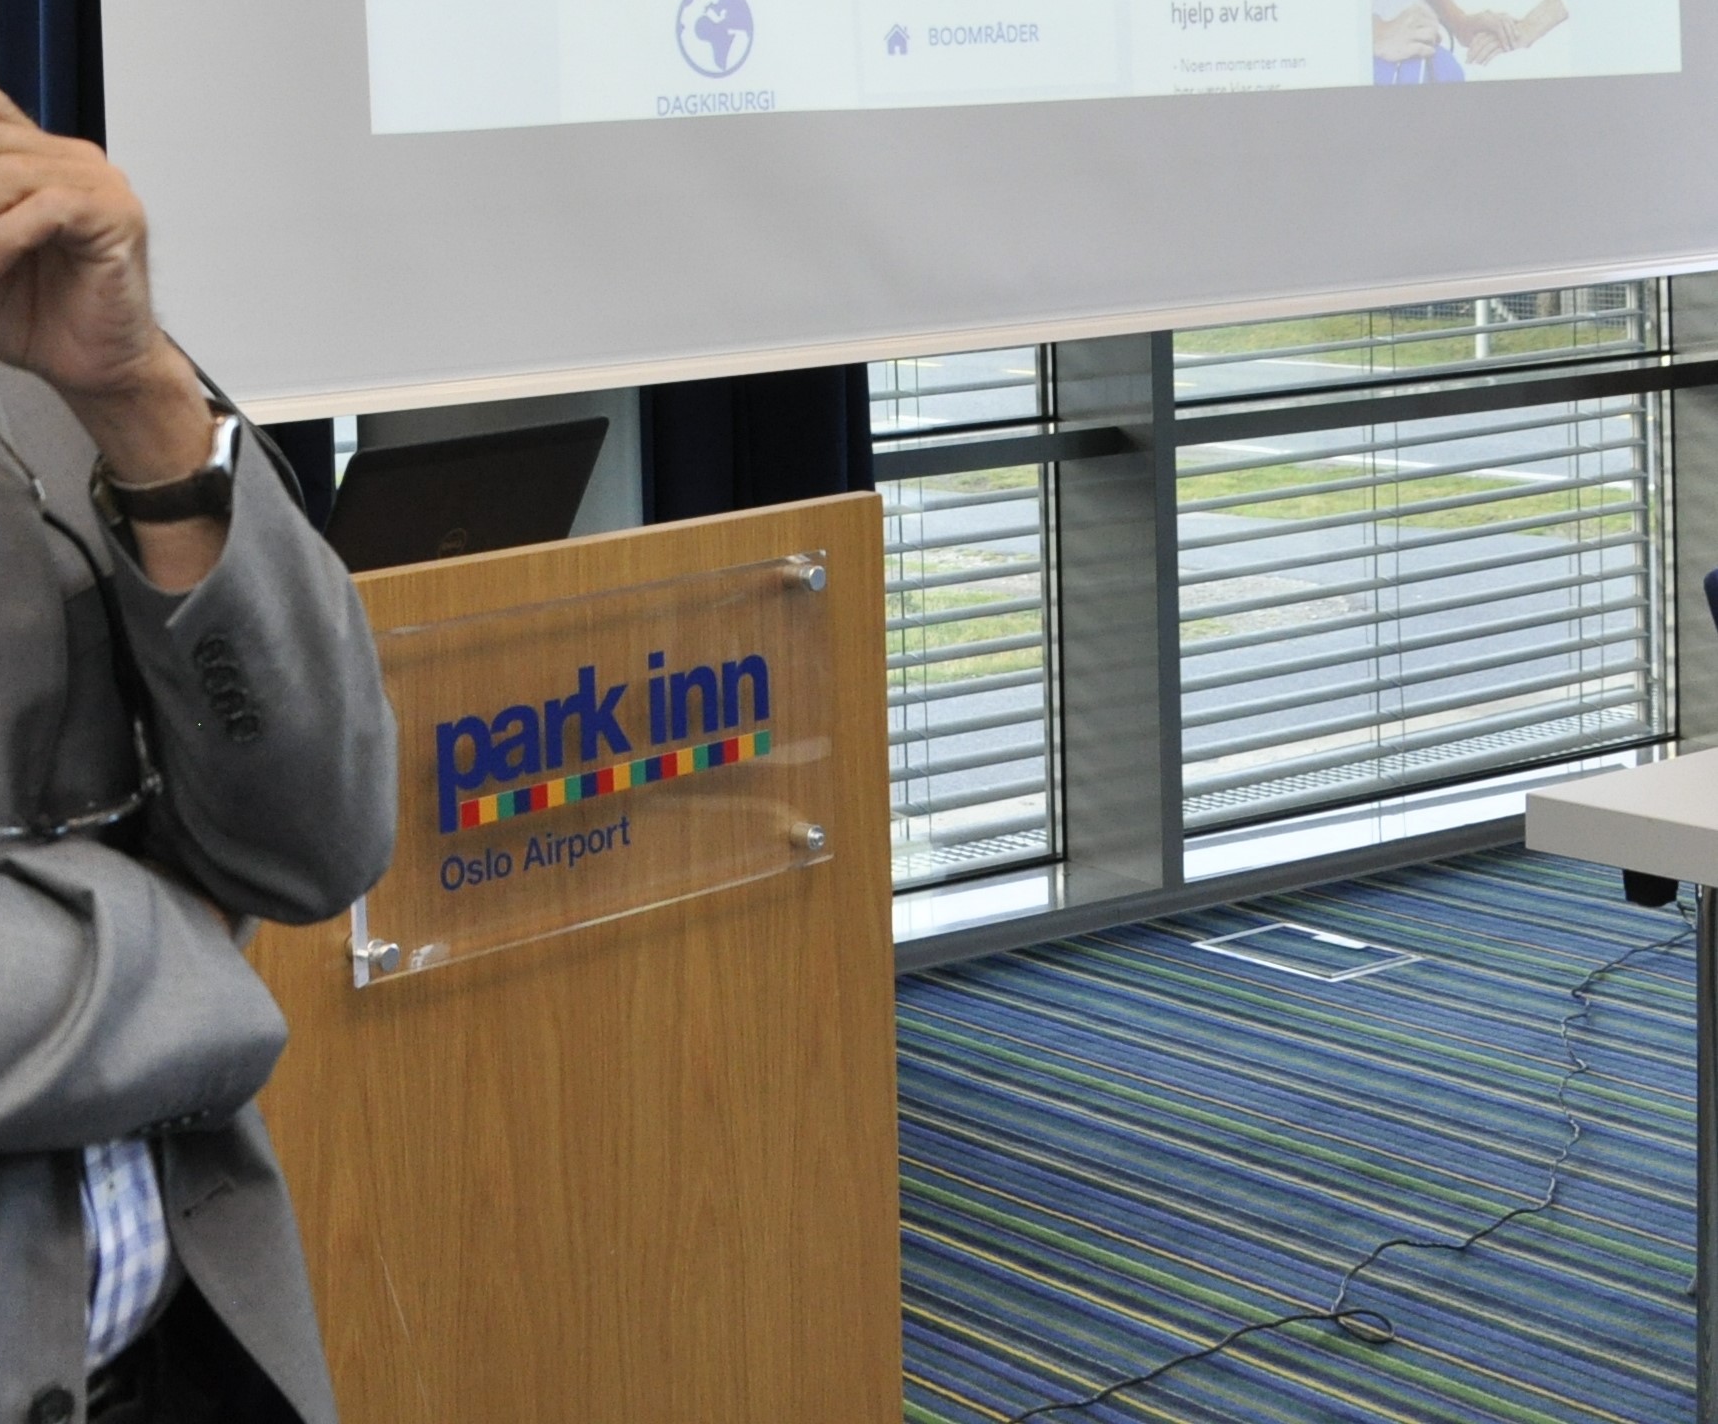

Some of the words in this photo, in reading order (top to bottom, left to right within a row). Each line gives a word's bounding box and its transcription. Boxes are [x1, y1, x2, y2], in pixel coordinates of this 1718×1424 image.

[1171, 2, 1214, 30] hjelp
[1219, 5, 1239, 23] av
[1244, 1, 1278, 23] kart
[928, 21, 1039, 47] BOOMRÅDER
[657, 90, 776, 117] DAGKIRURGI
[435, 665, 631, 834] park
[647, 651, 771, 745] inn
[439, 848, 512, 891] Oslo
[523, 815, 631, 869] Airport
